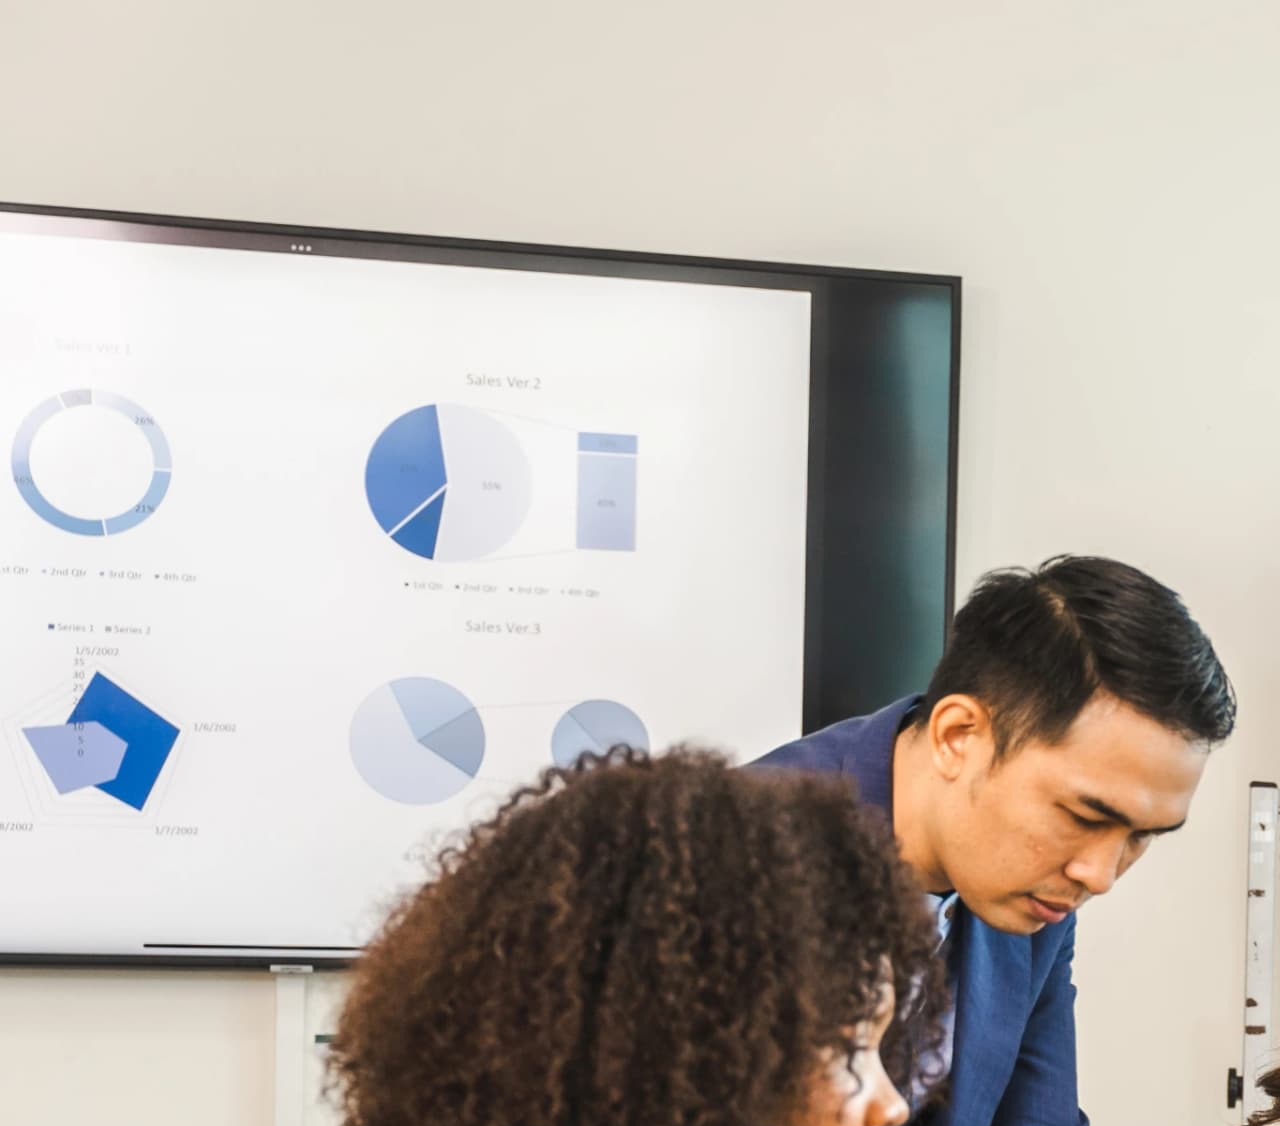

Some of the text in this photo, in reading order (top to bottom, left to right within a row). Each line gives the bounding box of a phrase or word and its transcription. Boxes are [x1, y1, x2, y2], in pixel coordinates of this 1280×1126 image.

[466, 373, 542, 390] Sales Ver.2
[57, 623, 86, 633] Series
[114, 625, 142, 635] Series
[465, 619, 502, 634] Sales
